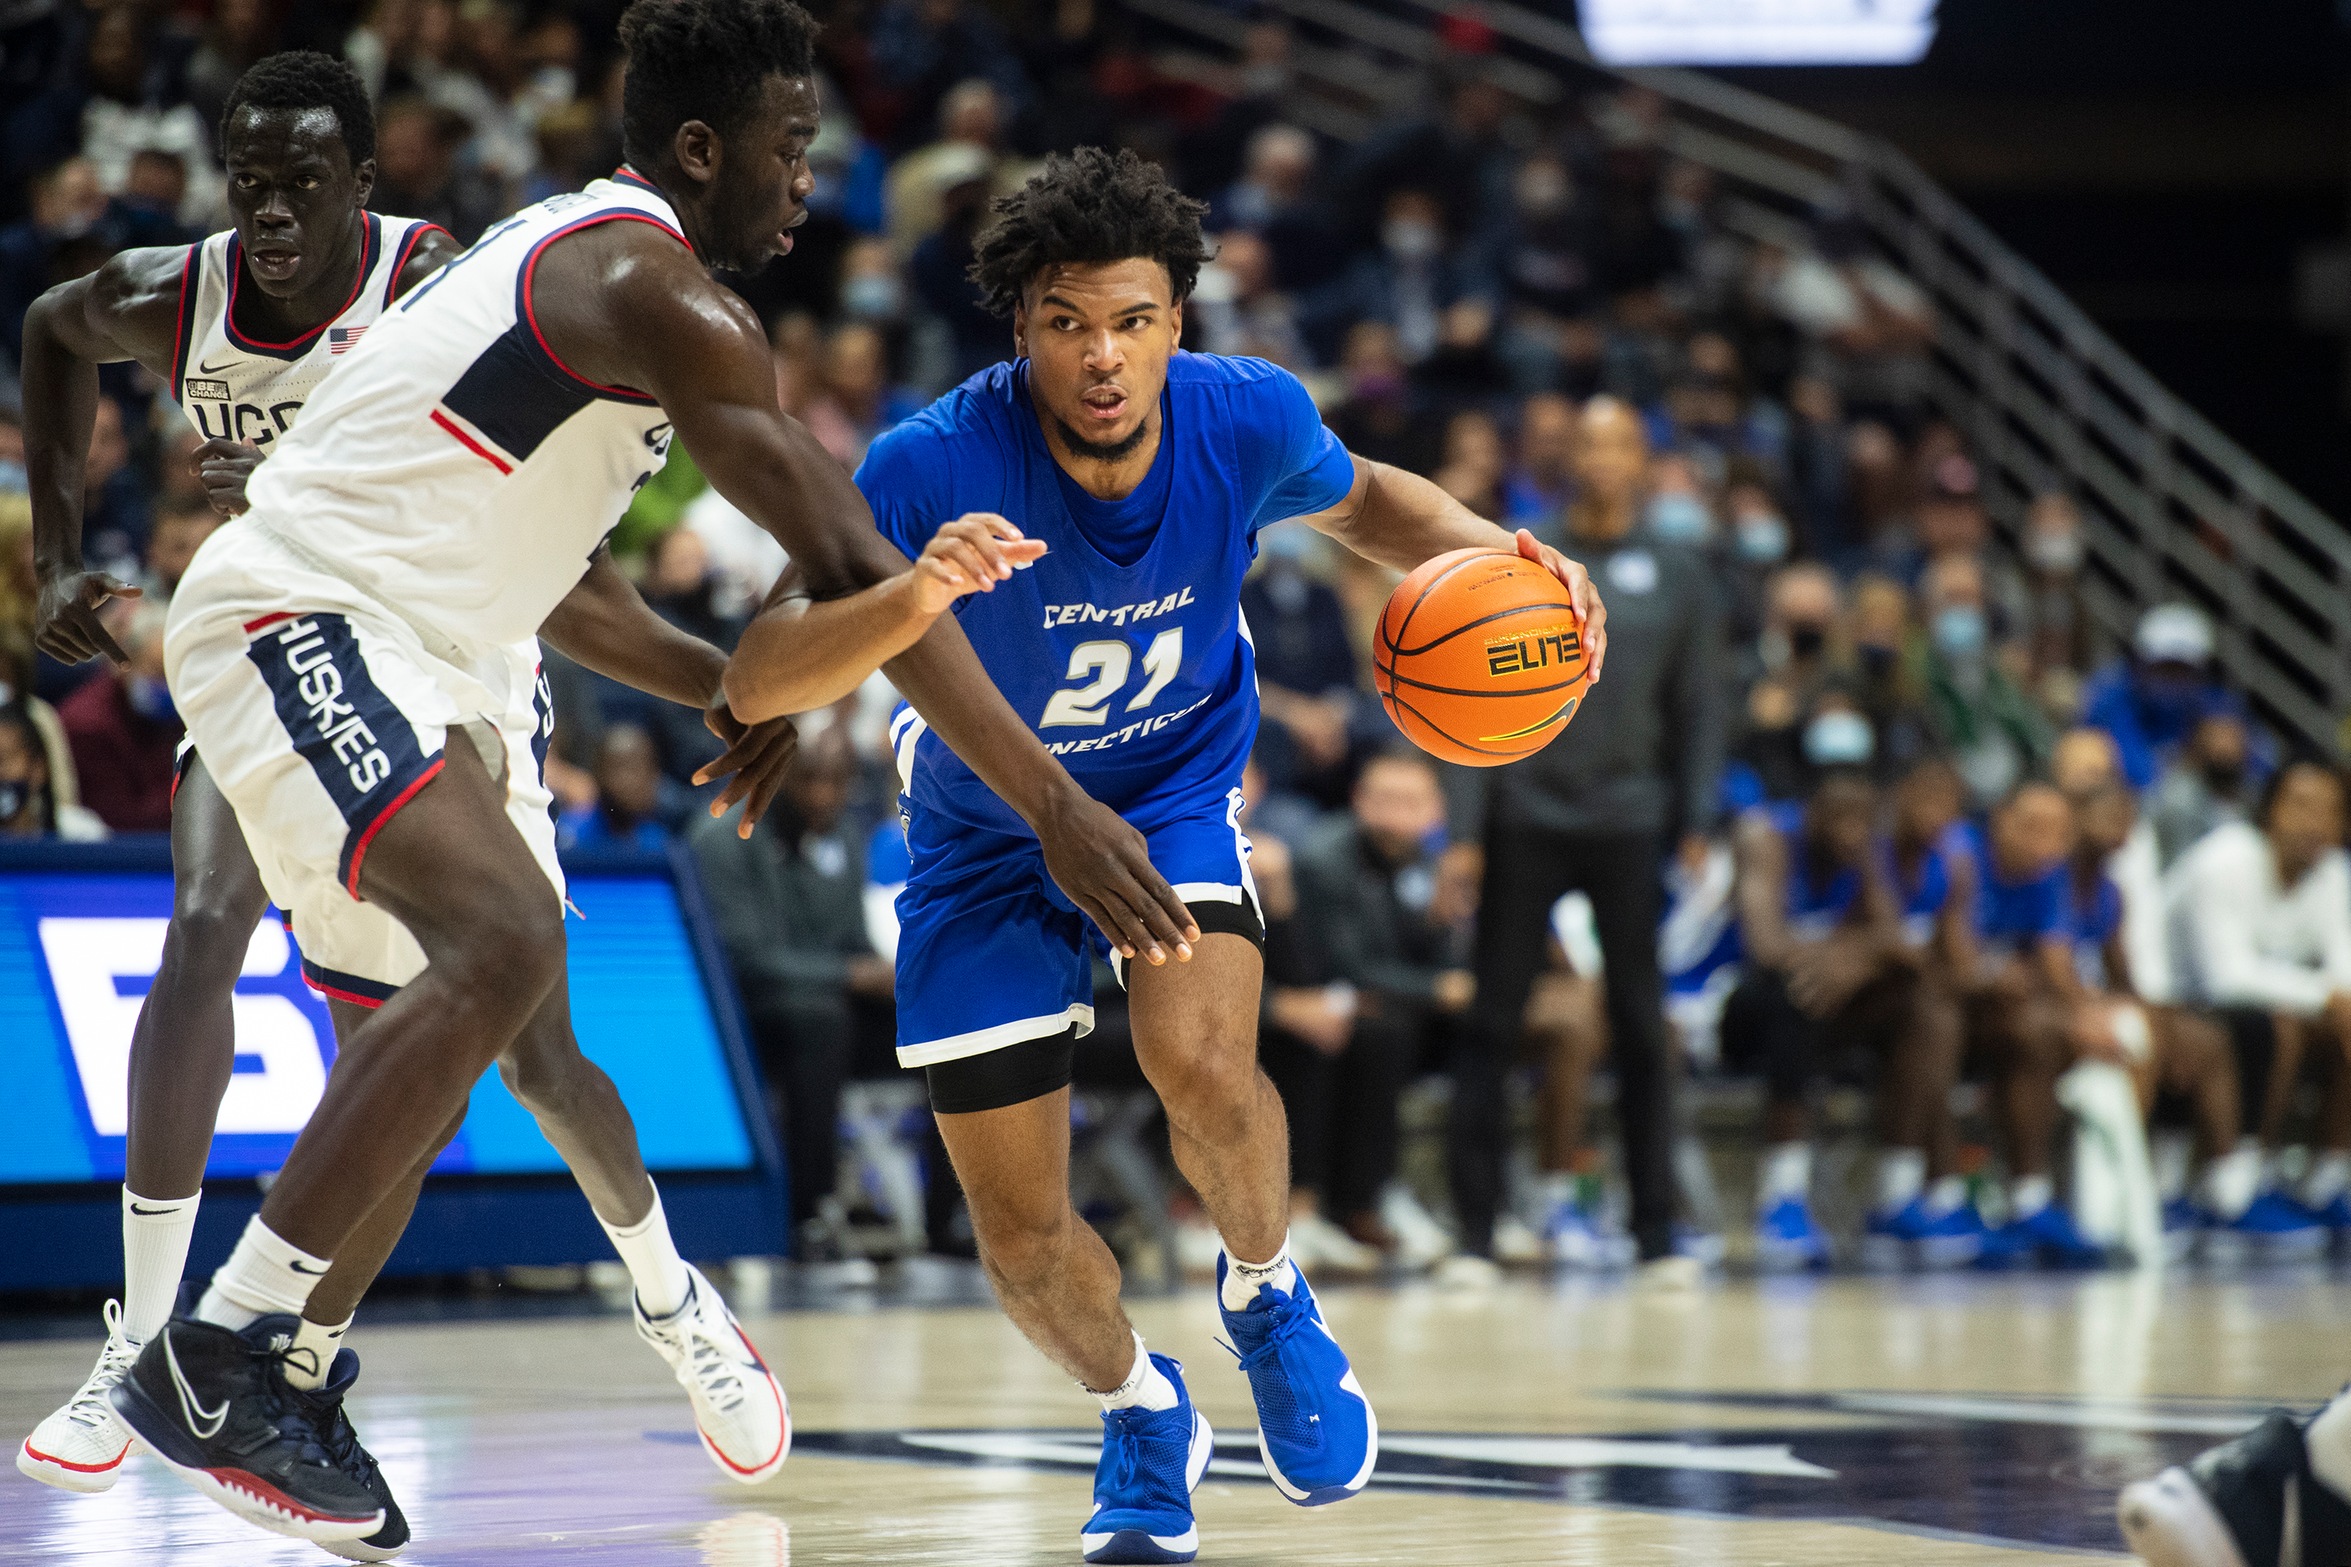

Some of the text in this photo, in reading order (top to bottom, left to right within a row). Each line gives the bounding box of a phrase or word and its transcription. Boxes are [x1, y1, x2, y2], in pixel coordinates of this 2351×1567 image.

[190, 390, 229, 399] CHANGE
[197, 381, 215, 391] BE
[1043, 586, 1195, 629] CENTRAL
[1487, 631, 1581, 677] ELITE
[1038, 626, 1183, 729] 21
[278, 620, 391, 794] HUSKIES
